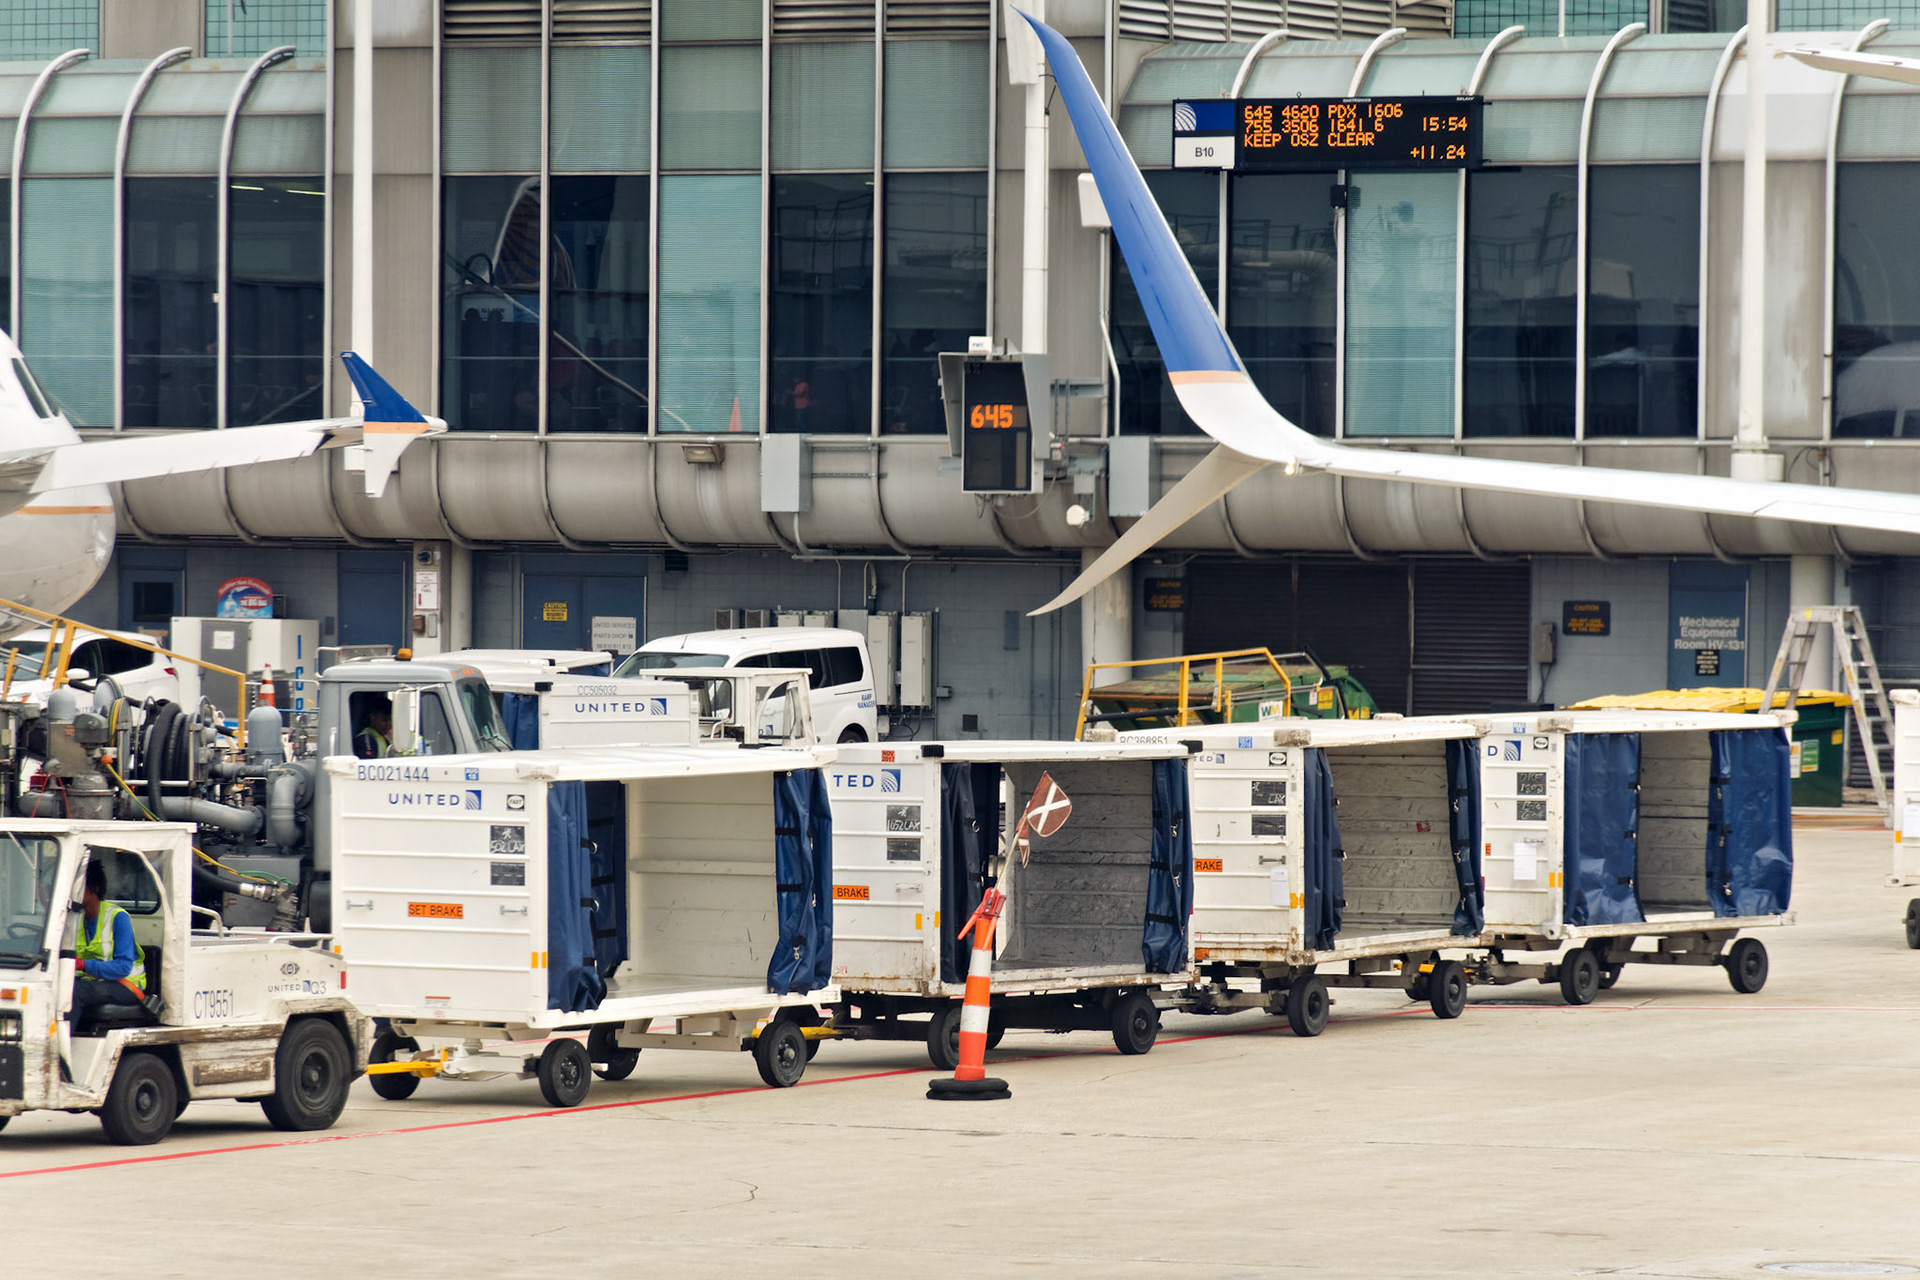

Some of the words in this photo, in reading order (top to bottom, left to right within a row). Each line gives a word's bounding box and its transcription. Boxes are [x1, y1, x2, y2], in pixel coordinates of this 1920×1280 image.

[1244, 105, 1273, 120] 645
[1281, 104, 1320, 119] 4620
[1327, 104, 1357, 119] PDX
[1368, 103, 1403, 118] 1606
[1244, 119, 1273, 133] 755
[1281, 119, 1319, 133] 3506
[1330, 118, 1363, 132] 1641
[1374, 117, 1384, 132] 6
[1423, 117, 1468, 131] 15:54
[1244, 133, 1282, 147] KEEP
[1327, 131, 1375, 147] CLEAR
[1195, 147, 1214, 157] B10
[970, 404, 1013, 428] 645
[1679, 616, 1739, 627] Mechanical
[1681, 627, 1738, 638] Equipment
[1674, 639, 1706, 649] Room
[577, 685, 618, 695] CC505032
[575, 702, 645, 713] UNITED
[358, 765, 430, 781] BC021444
[833, 775, 875, 787] TED
[388, 793, 460, 806] UNITED
[1196, 861, 1222, 870] RAKE
[837, 887, 869, 898] BRAKE
[408, 904, 426, 915] SET
[430, 905, 463, 917] BRAKE
[268, 984, 301, 993] UNITED
[311, 981, 327, 995] Q3
[194, 988, 234, 1019] CT9551
